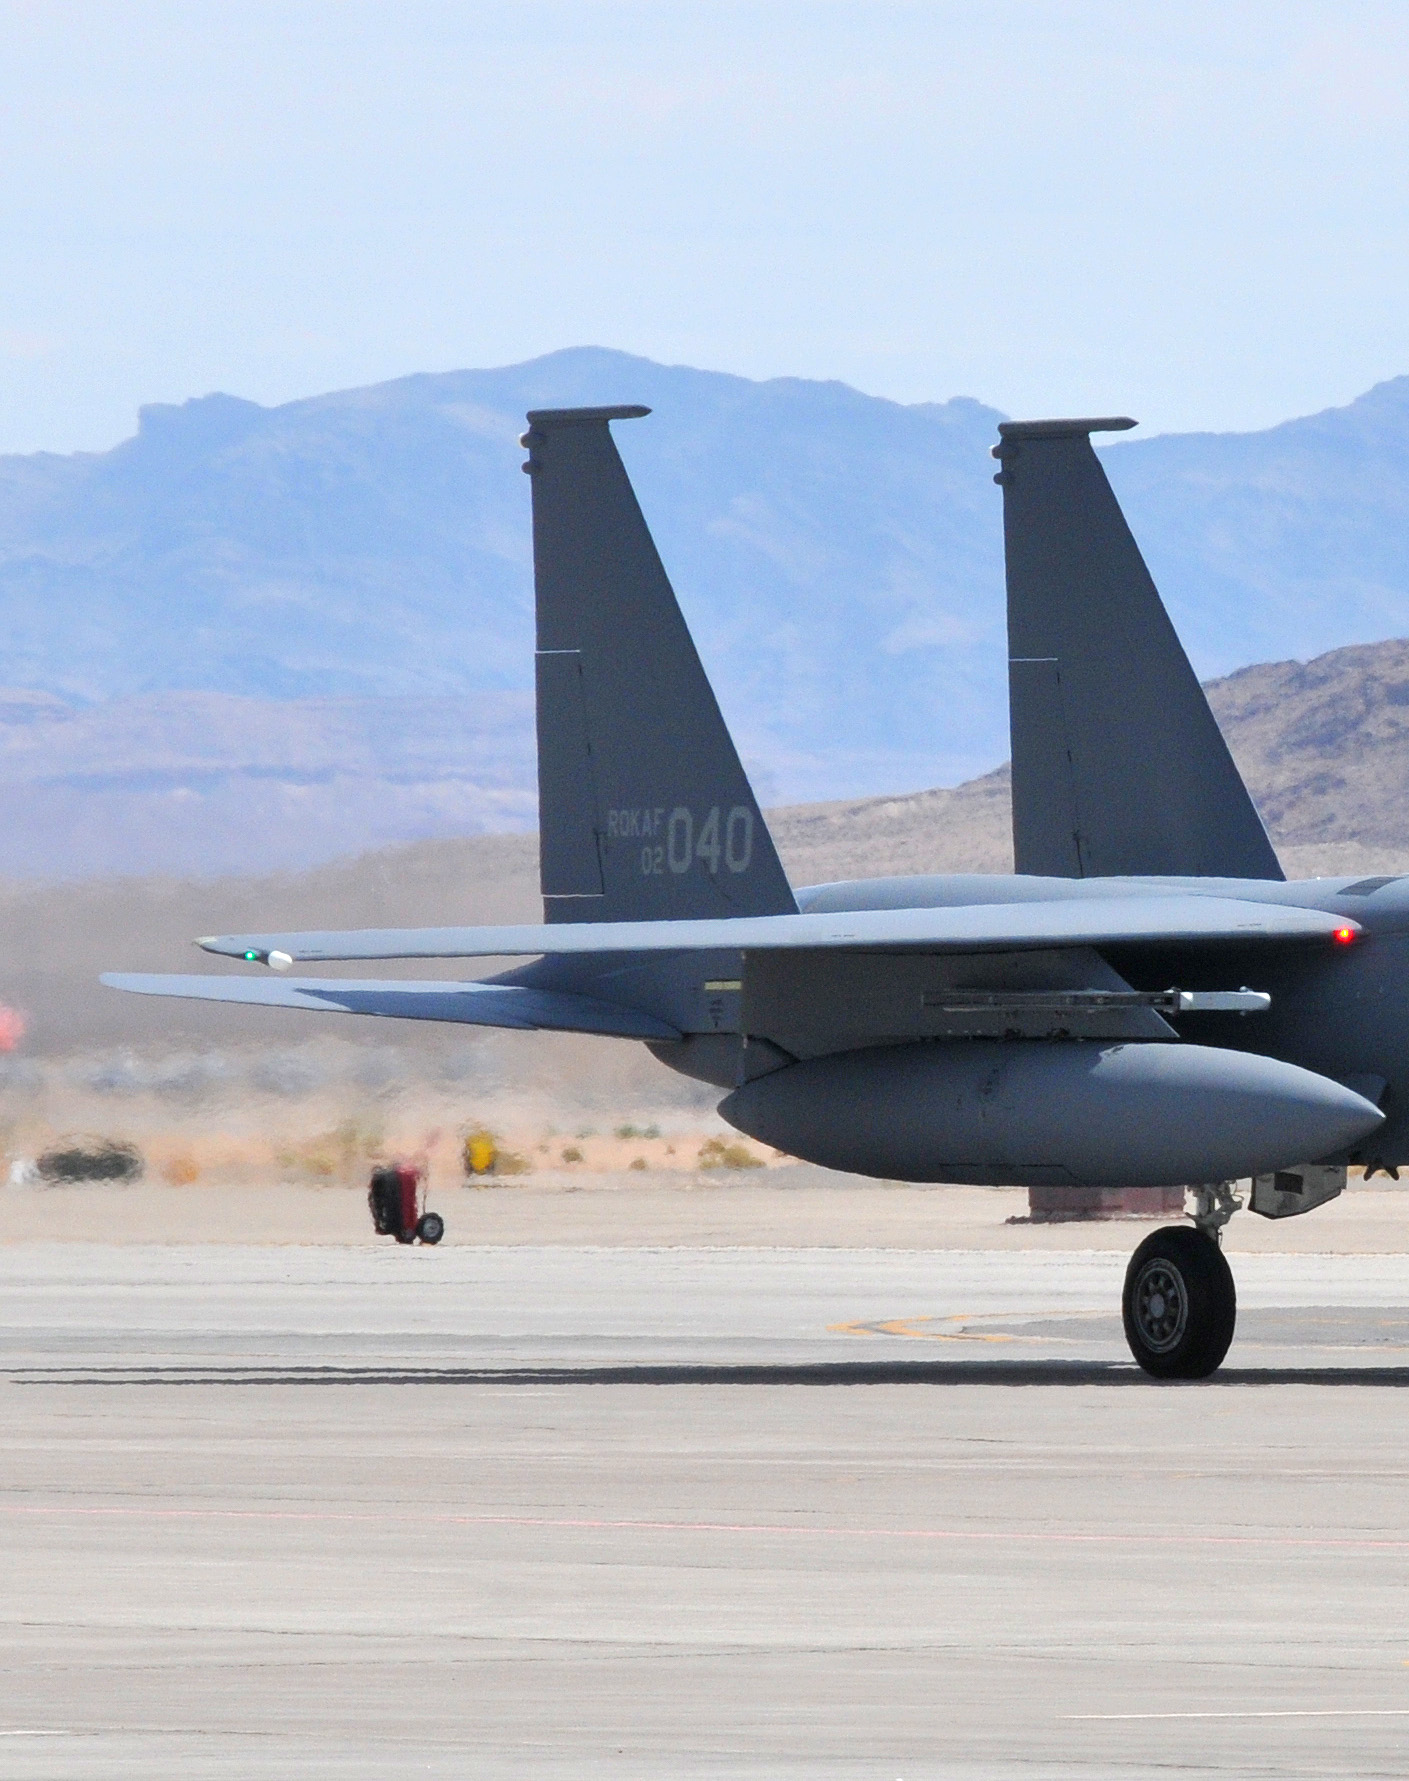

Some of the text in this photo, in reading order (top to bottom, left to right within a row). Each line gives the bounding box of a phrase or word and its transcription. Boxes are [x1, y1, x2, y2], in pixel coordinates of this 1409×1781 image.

[607, 808, 664, 837] ROKAF
[668, 806, 754, 874] 040
[641, 846, 665, 875] 02
